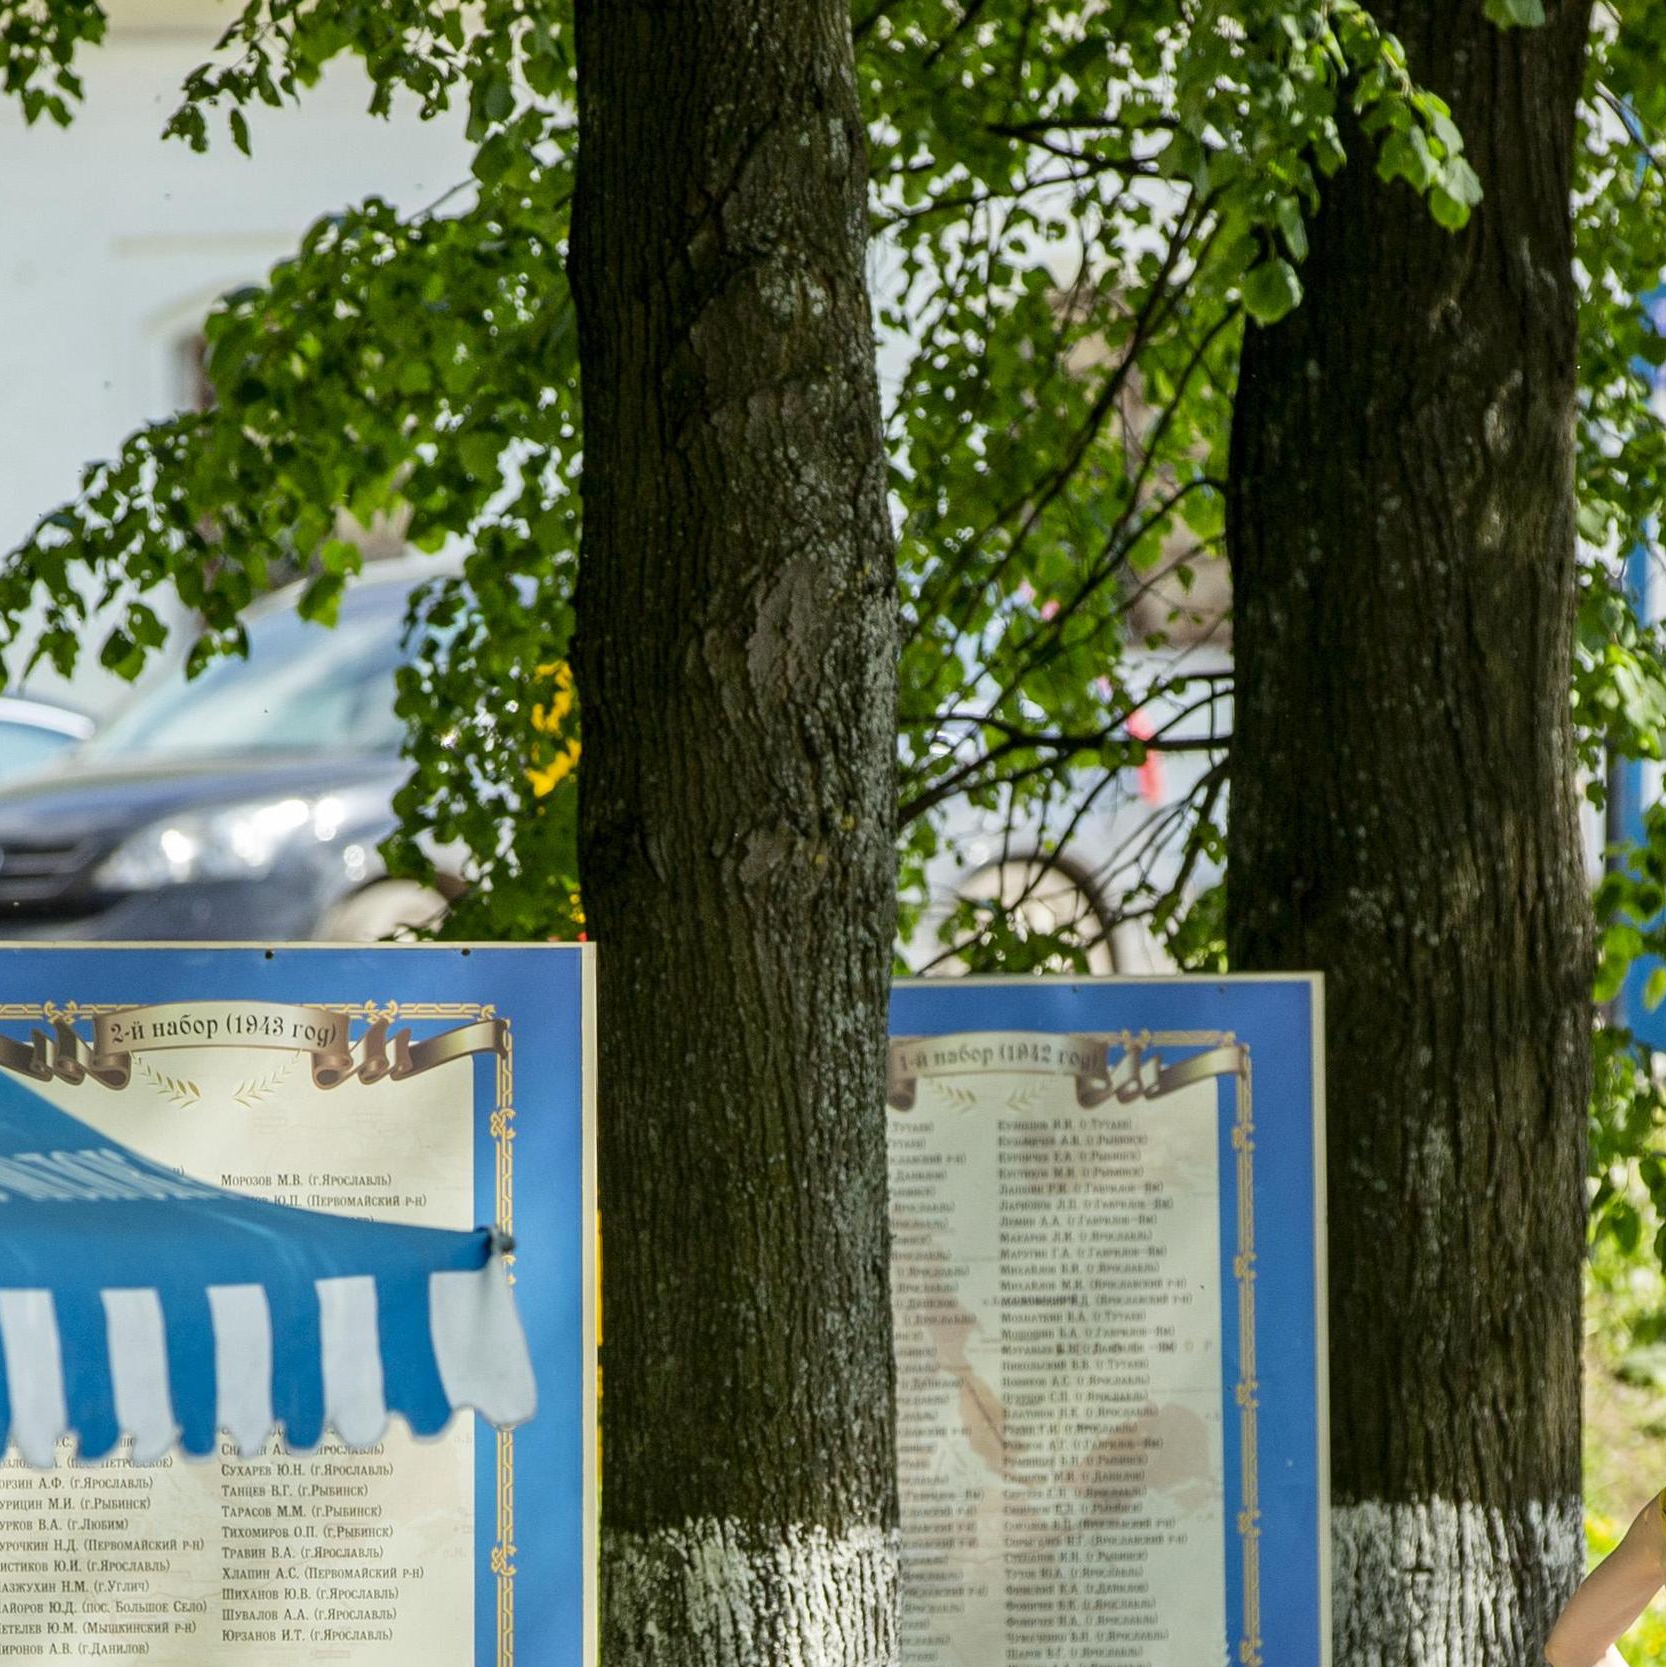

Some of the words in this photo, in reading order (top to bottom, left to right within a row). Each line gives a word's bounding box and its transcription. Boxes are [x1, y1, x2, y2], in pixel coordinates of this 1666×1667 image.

[110, 1022, 145, 1043] 2-й
[152, 1015, 219, 1038] набор
[226, 1014, 284, 1036] (1943
[291, 1023, 337, 1048] год)
[933, 1042, 993, 1066] набор
[277, 1174, 303, 1186] М.В.
[405, 1195, 427, 1206] р-н)
[277, 1464, 304, 1476] Ю.Н.
[38, 1477, 65, 1489] А.Ф.
[271, 1484, 293, 1496] В.Г.
[48, 1498, 75, 1509] М.И.
[277, 1505, 306, 1517] М.М.
[38, 1519, 62, 1530] В.А.
[293, 1526, 317, 1538] О.П.
[54, 1539, 79, 1553] Н.Д.
[182, 1538, 205, 1551] р-н)
[271, 1547, 295, 1558] В.А.
[54, 1560, 82, 1572] Ю.И.
[275, 1567, 299, 1579] А.С.
[403, 1567, 424, 1578] р-н)
[61, 1581, 89, 1592] Н.М.
[284, 1588, 311, 1600] Ю.В.
[49, 1601, 77, 1615] Ю.Д.
[82, 1600, 110, 1613] (пос.
[173, 1600, 207, 1612] Село)
[284, 1609, 309, 1620] А.А.
[47, 1622, 77, 1634] Ю.М.
[174, 1621, 197, 1633] р-н)
[281, 1629, 305, 1641] И.Т.
[49, 1643, 72, 1654] А.В.
